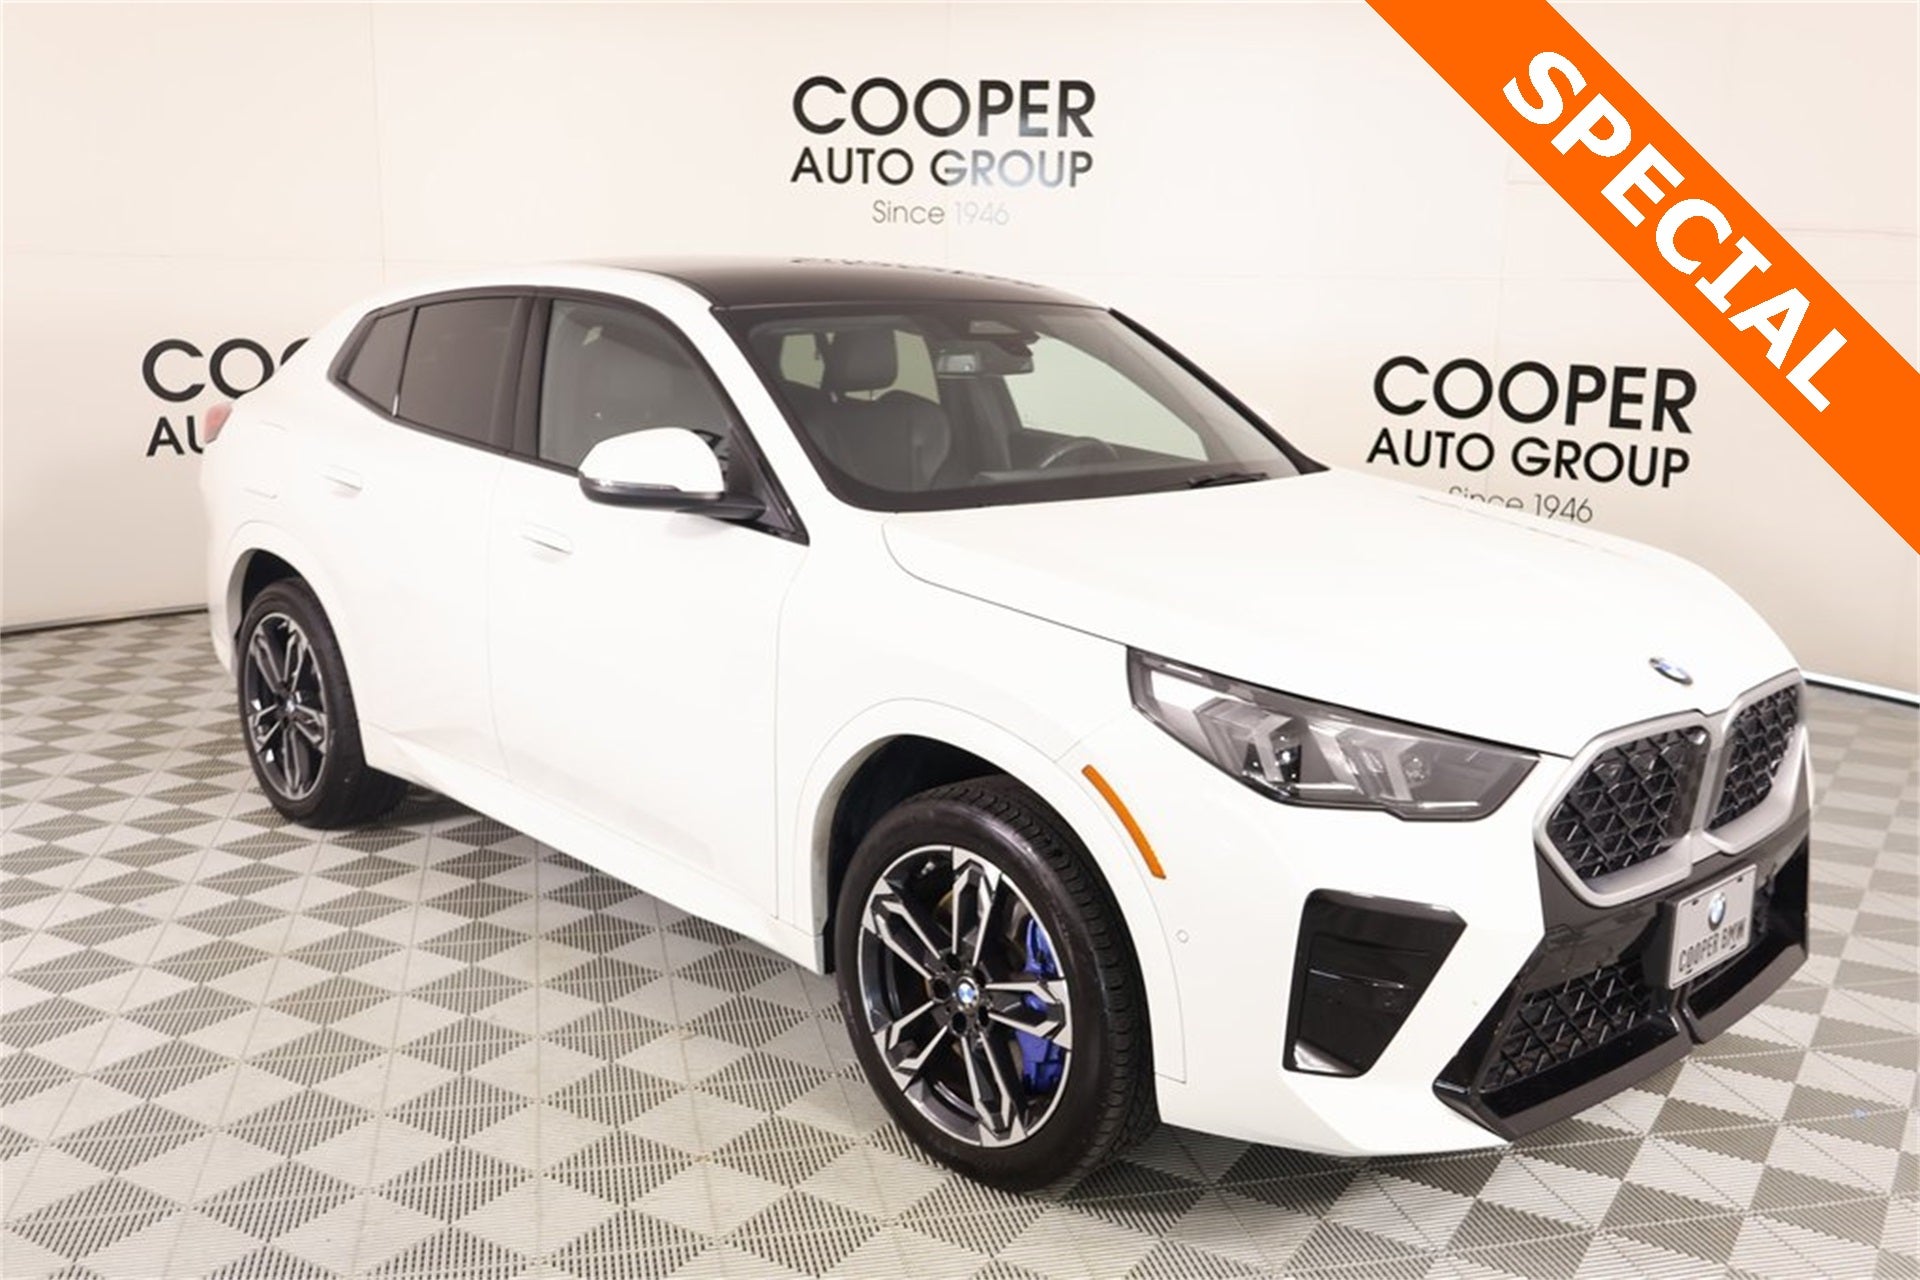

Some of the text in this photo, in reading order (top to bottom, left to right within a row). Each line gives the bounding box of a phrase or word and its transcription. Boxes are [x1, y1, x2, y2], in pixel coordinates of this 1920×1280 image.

[792, 75, 1096, 138] COOPER
[790, 146, 1094, 188] AUTO GROUP
[872, 199, 1010, 226] Since 1946
[141, 338, 310, 403] CO
[1373, 355, 1698, 434] COOPER
[1365, 427, 1690, 489] AUTO GROUP
[1535, 493, 1593, 524] 1946
[1678, 916, 1747, 973] COOPER BMW
